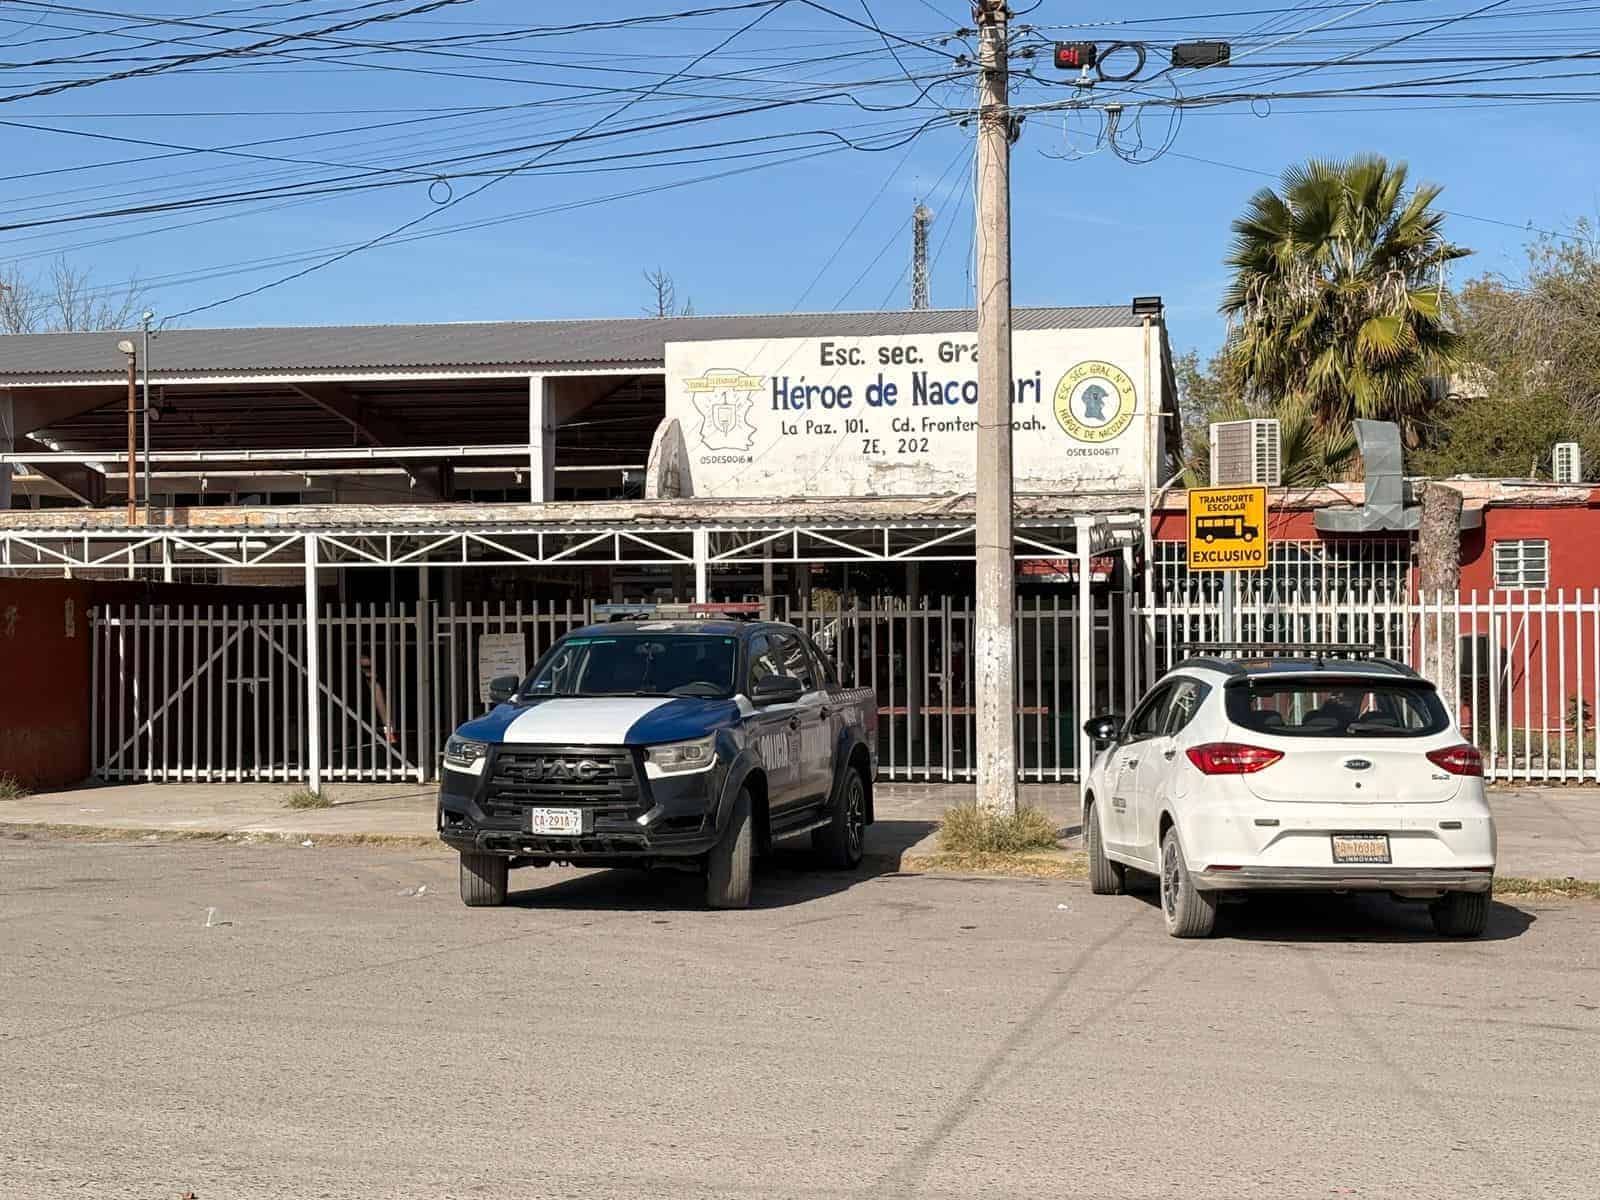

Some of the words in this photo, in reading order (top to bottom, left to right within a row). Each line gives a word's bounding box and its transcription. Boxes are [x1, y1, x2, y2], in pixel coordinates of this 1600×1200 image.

[820, 342, 866, 366] Esc.
[878, 345, 924, 365] sec.
[938, 341, 979, 363] Gra
[771, 375, 852, 410] Héroe
[865, 373, 899, 407] de
[912, 370, 1042, 407] Nacori
[781, 420, 798, 436] La
[806, 419, 837, 435] Paz.
[845, 418, 869, 434] 101.
[892, 417, 915, 433] Cd.
[921, 416, 979, 433] Fronter
[1011, 415, 1047, 432] oah.
[862, 438, 886, 456] ZE,
[897, 438, 929, 454] 202
[1199, 494, 1254, 504] TRANSPORTE
[1207, 503, 1246, 512] ESCOLAR
[1193, 550, 1262, 562] EXCLUSIVO
